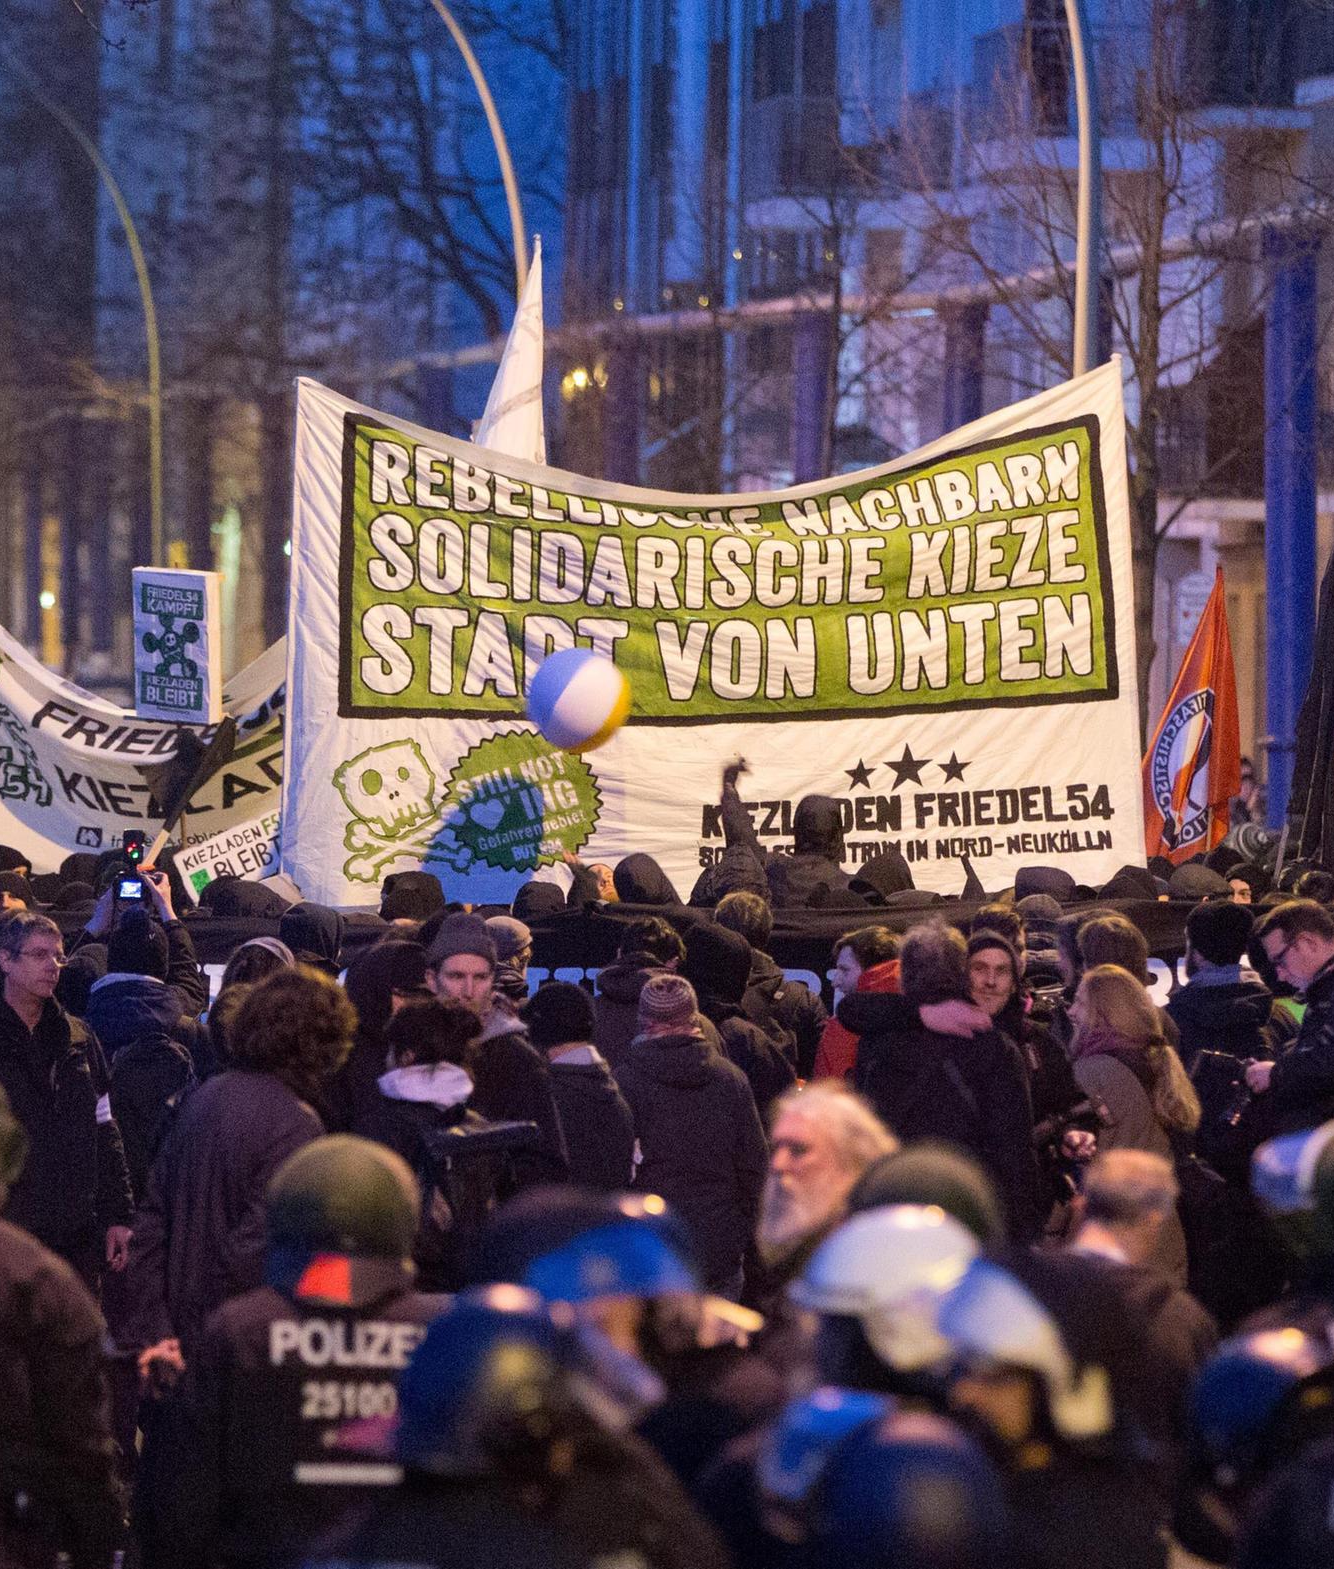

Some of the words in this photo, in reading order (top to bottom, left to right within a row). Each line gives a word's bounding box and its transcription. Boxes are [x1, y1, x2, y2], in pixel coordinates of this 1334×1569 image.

[781, 441, 1079, 537] NACHBARN
[368, 512, 885, 609] SOLIDARISCHE
[907, 508, 1086, 599] KIEZE
[655, 617, 816, 699] VON
[845, 593, 1093, 695] UNTEN
[147, 685, 197, 707] BLEIBT
[456, 766, 520, 803] STILL
[519, 751, 565, 784] NOT
[915, 784, 1114, 829] FRIEDEL54
[182, 825, 263, 871] KIEZLADEN
[270, 1317, 428, 1369] POLIZE
